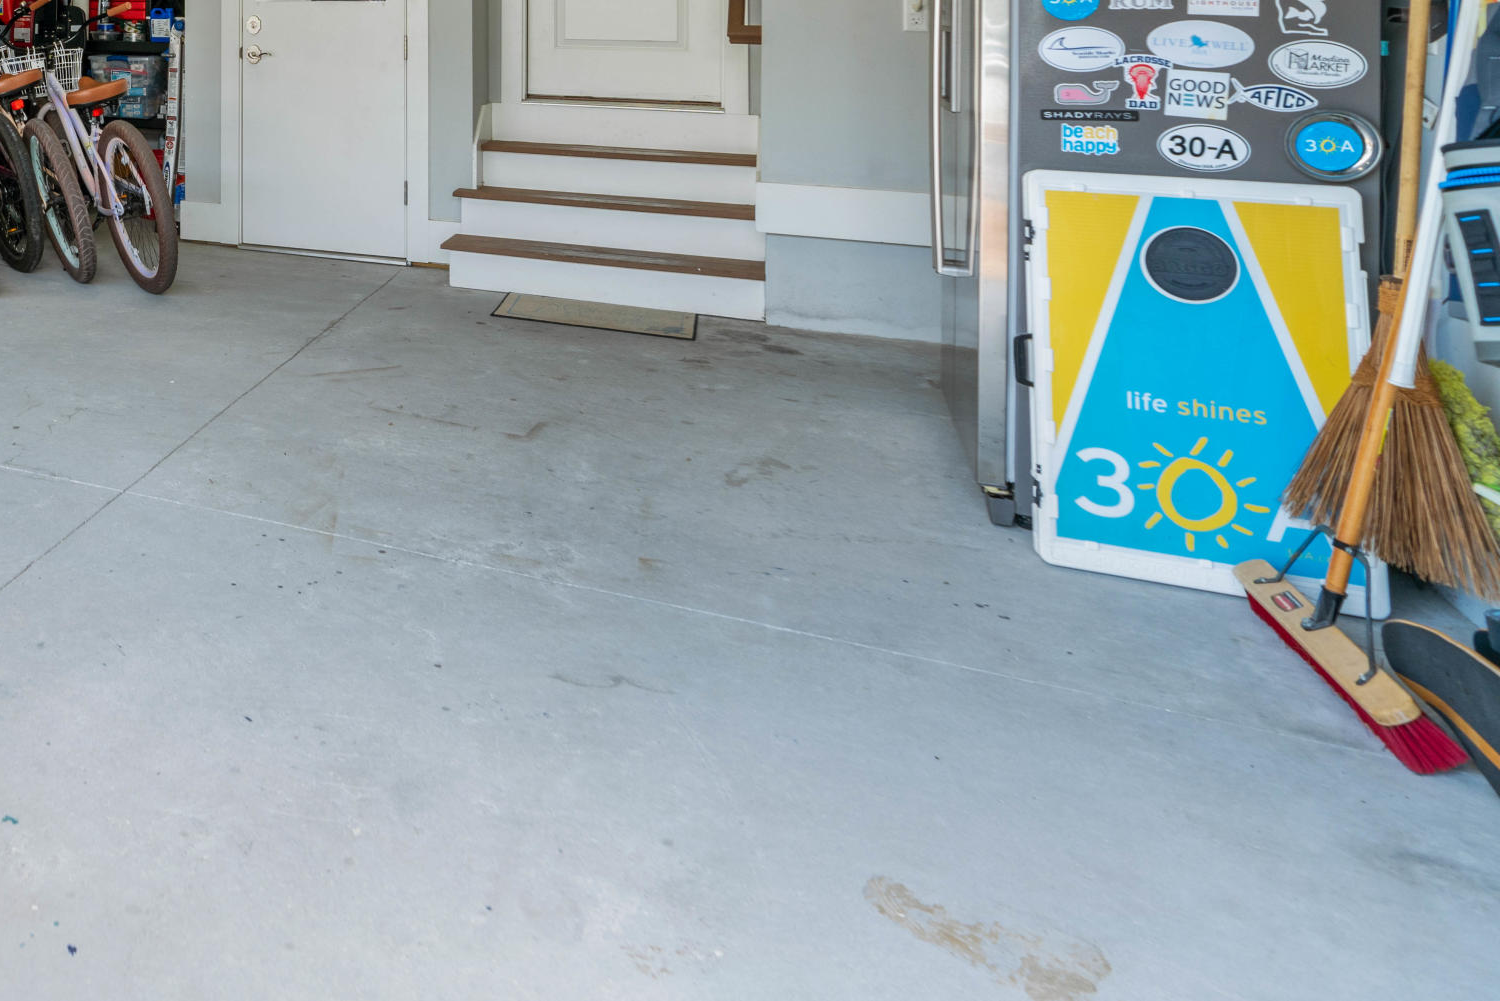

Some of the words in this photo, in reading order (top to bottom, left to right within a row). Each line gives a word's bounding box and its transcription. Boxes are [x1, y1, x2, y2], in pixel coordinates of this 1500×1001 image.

[1152, 37, 1187, 47] LIVE
[1210, 40, 1248, 52] WELL
[1114, 56, 1172, 68] LACROSSE
[1168, 78, 1226, 94] GOOD
[1129, 100, 1158, 109] DAD
[1168, 93, 1226, 110] NEWS
[1250, 88, 1306, 109] AFTCO
[1063, 125, 1117, 140] beach
[1062, 139, 1116, 154] happy
[1168, 135, 1238, 161] 30-A
[1305, 139, 1355, 153] 30A
[1126, 390, 1168, 413] life
[1177, 398, 1268, 426] shines
